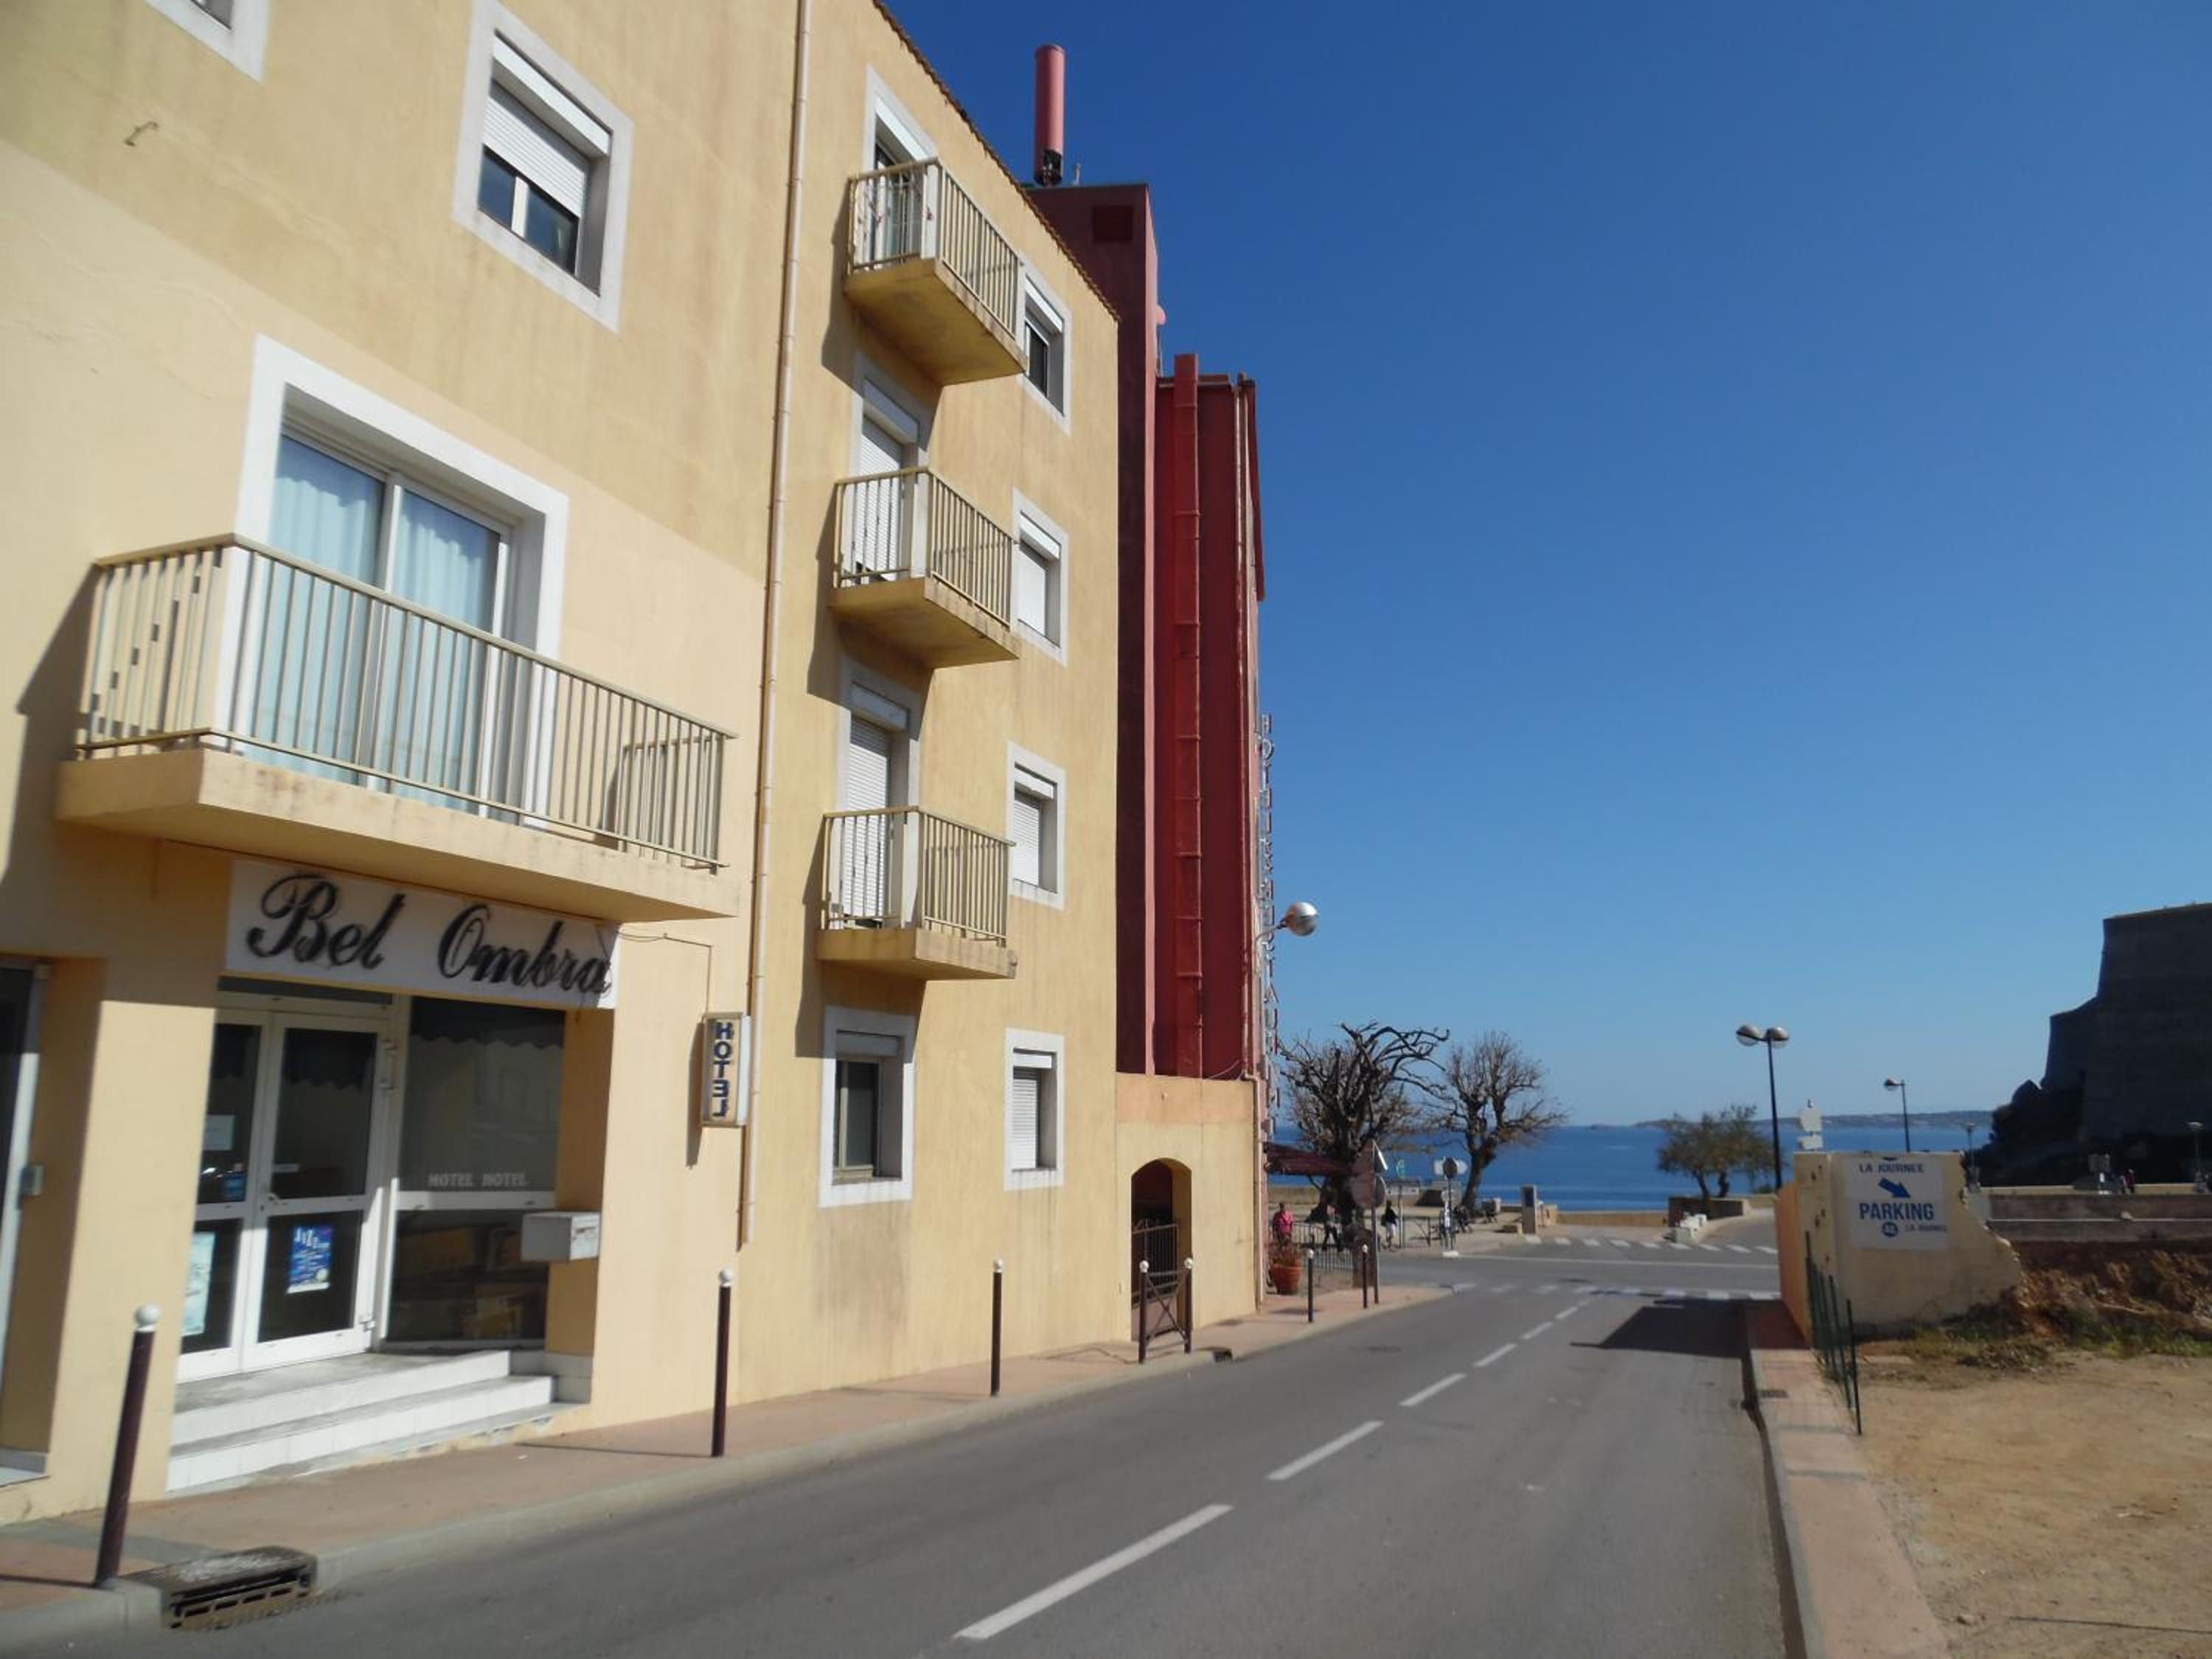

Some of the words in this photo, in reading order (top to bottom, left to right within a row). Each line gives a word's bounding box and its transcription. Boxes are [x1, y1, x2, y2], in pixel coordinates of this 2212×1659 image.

[246, 873, 406, 969] Bel
[438, 903, 613, 994] Ombra
[1859, 1203, 1934, 1220] PARKING
